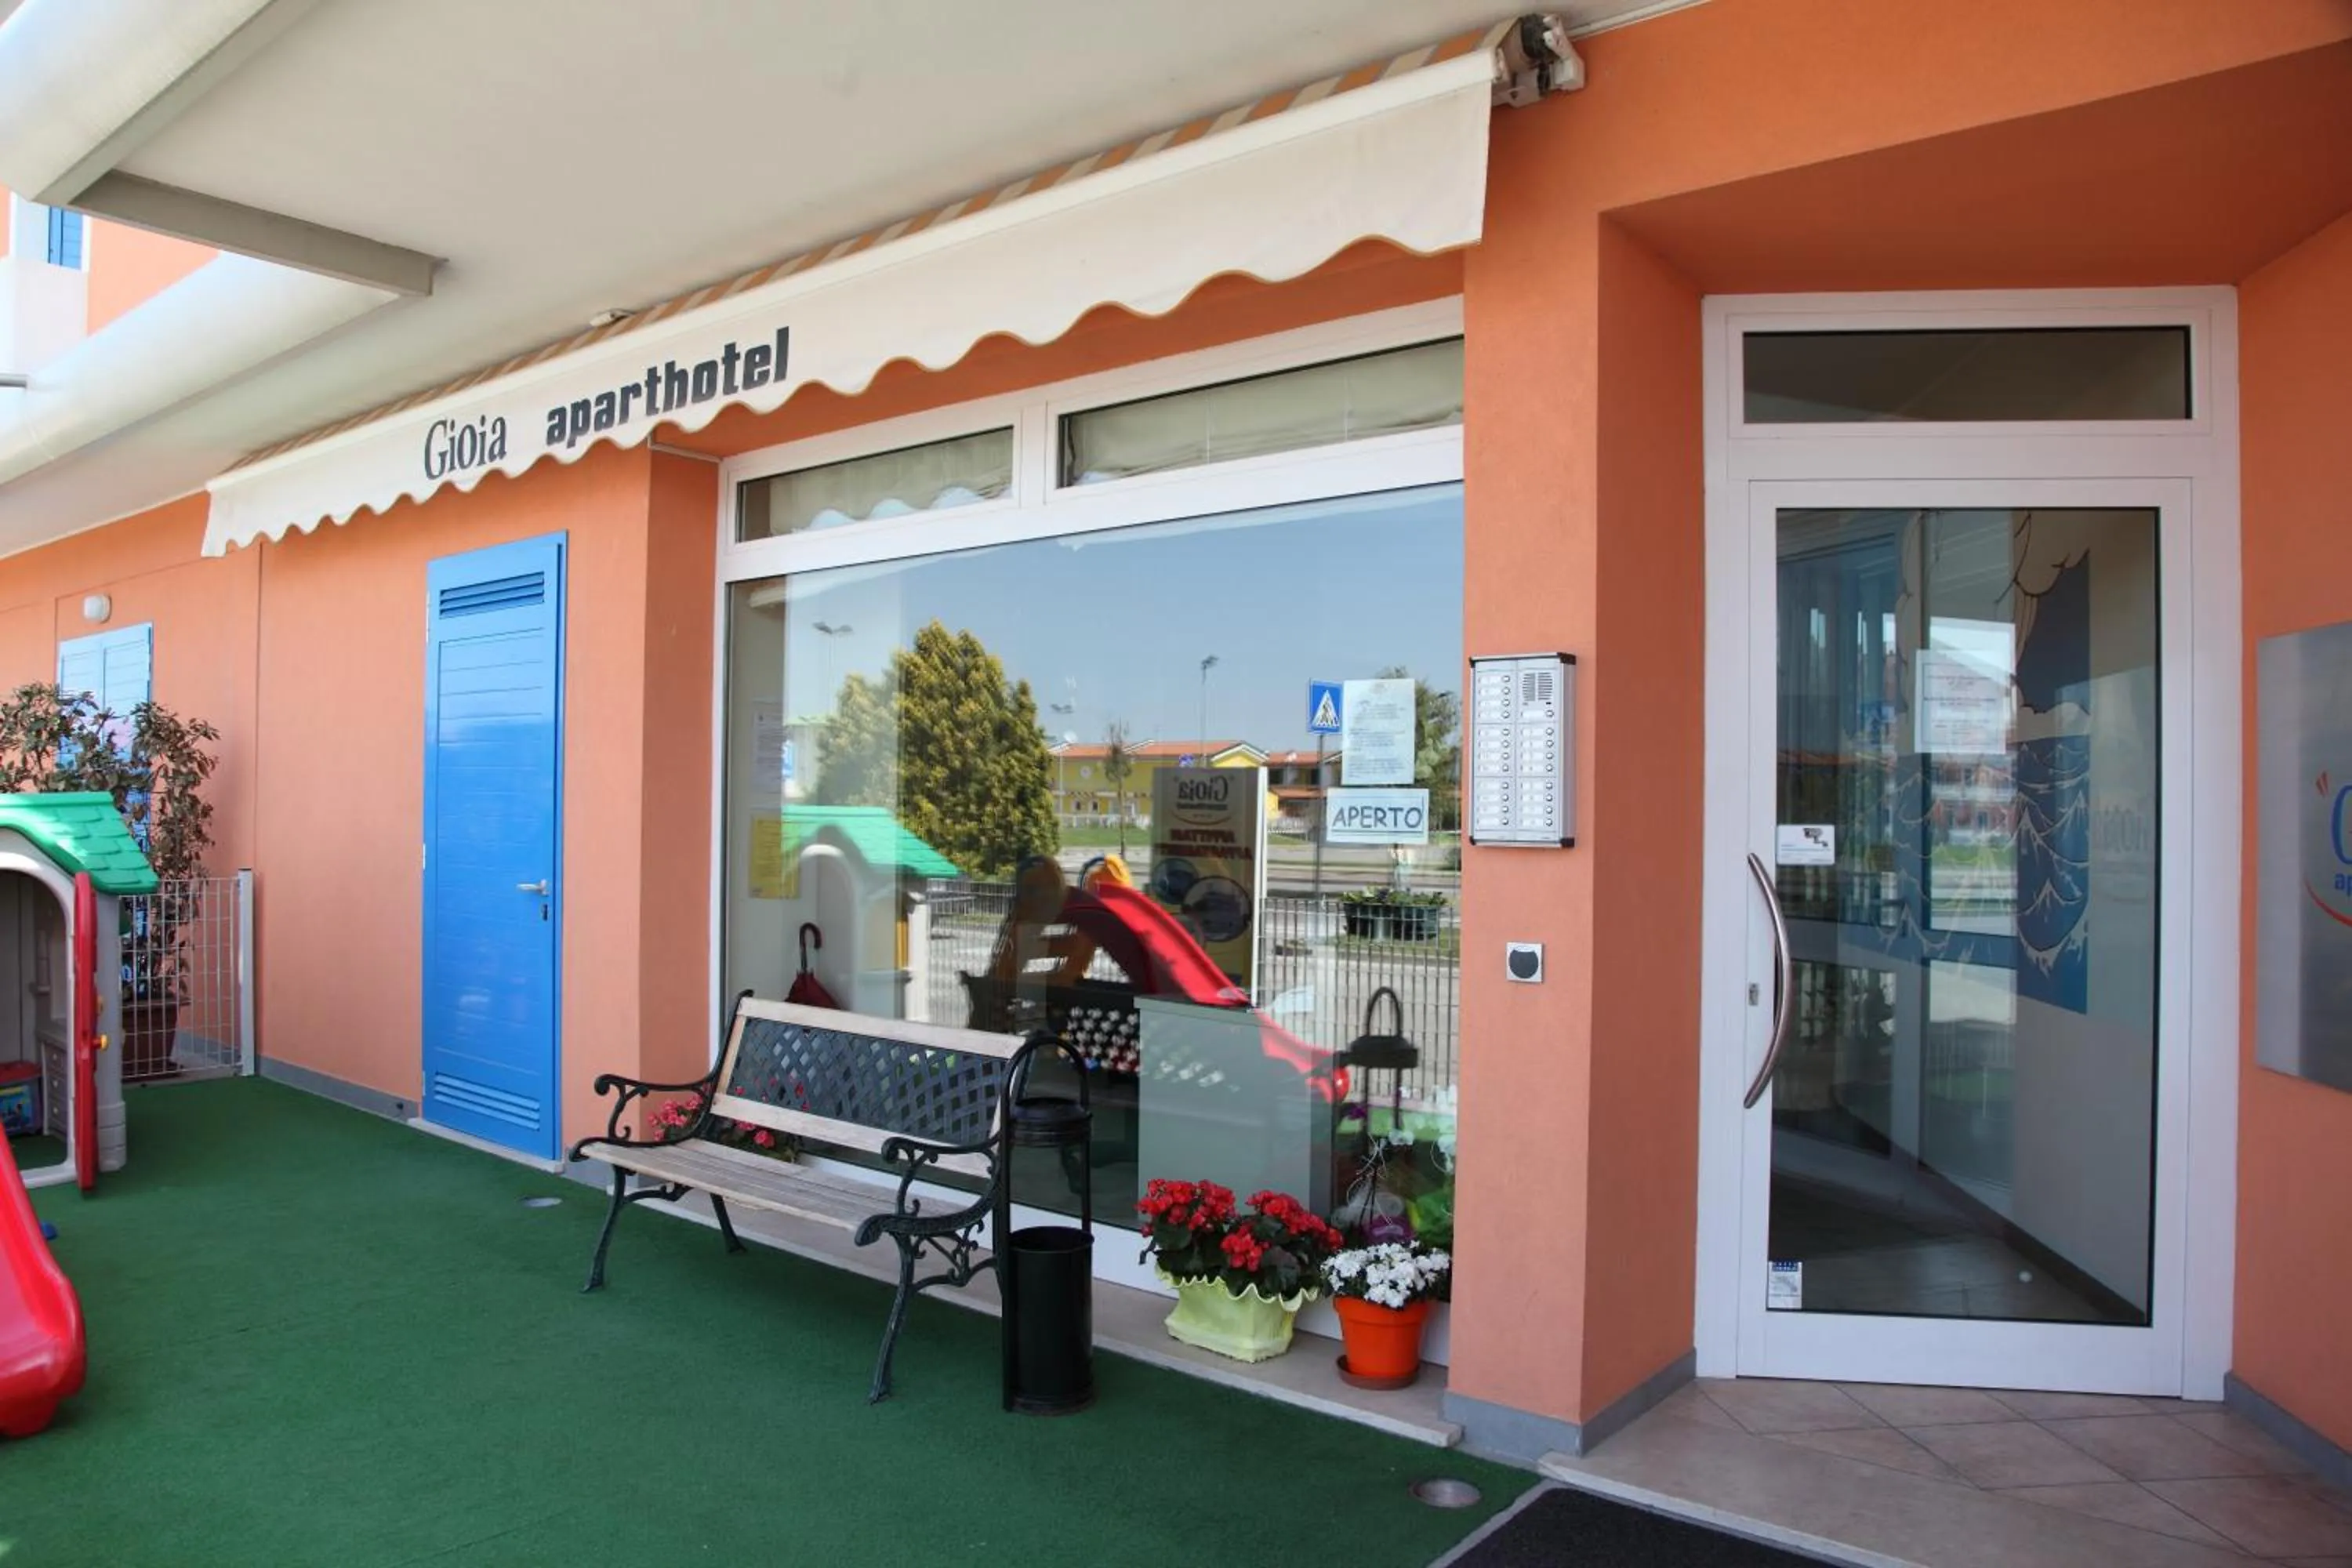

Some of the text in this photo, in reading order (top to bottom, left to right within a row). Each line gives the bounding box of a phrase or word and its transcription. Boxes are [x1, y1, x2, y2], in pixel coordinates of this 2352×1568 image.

[424, 325, 790, 481] Gioia aparthotel
[1332, 805, 1423, 829] APERTO
